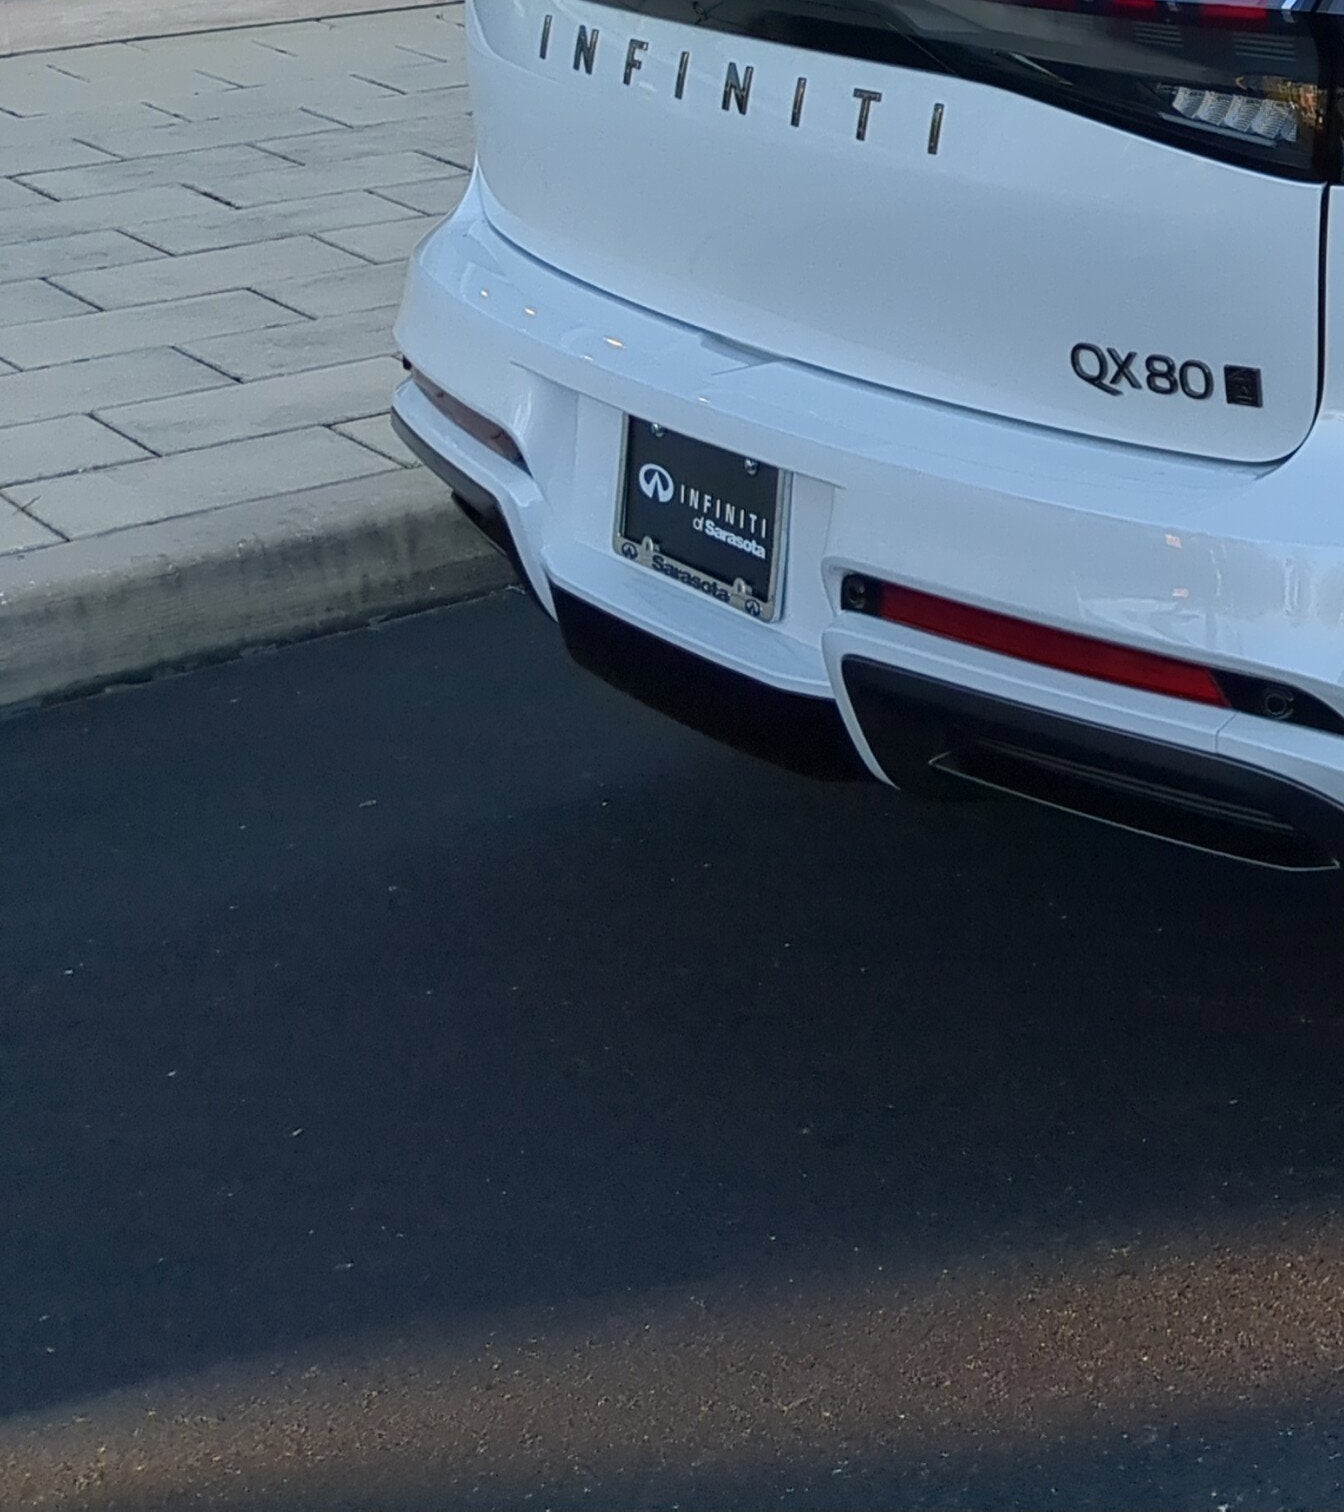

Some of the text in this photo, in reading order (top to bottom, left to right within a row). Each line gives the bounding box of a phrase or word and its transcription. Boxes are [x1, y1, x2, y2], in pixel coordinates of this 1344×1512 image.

[539, 14, 944, 155] INFINITI
[1070, 342, 1214, 400] QX80
[680, 484, 767, 539] INFINITI
[704, 519, 766, 560] Sarasota
[652, 554, 731, 603] Sarasota
